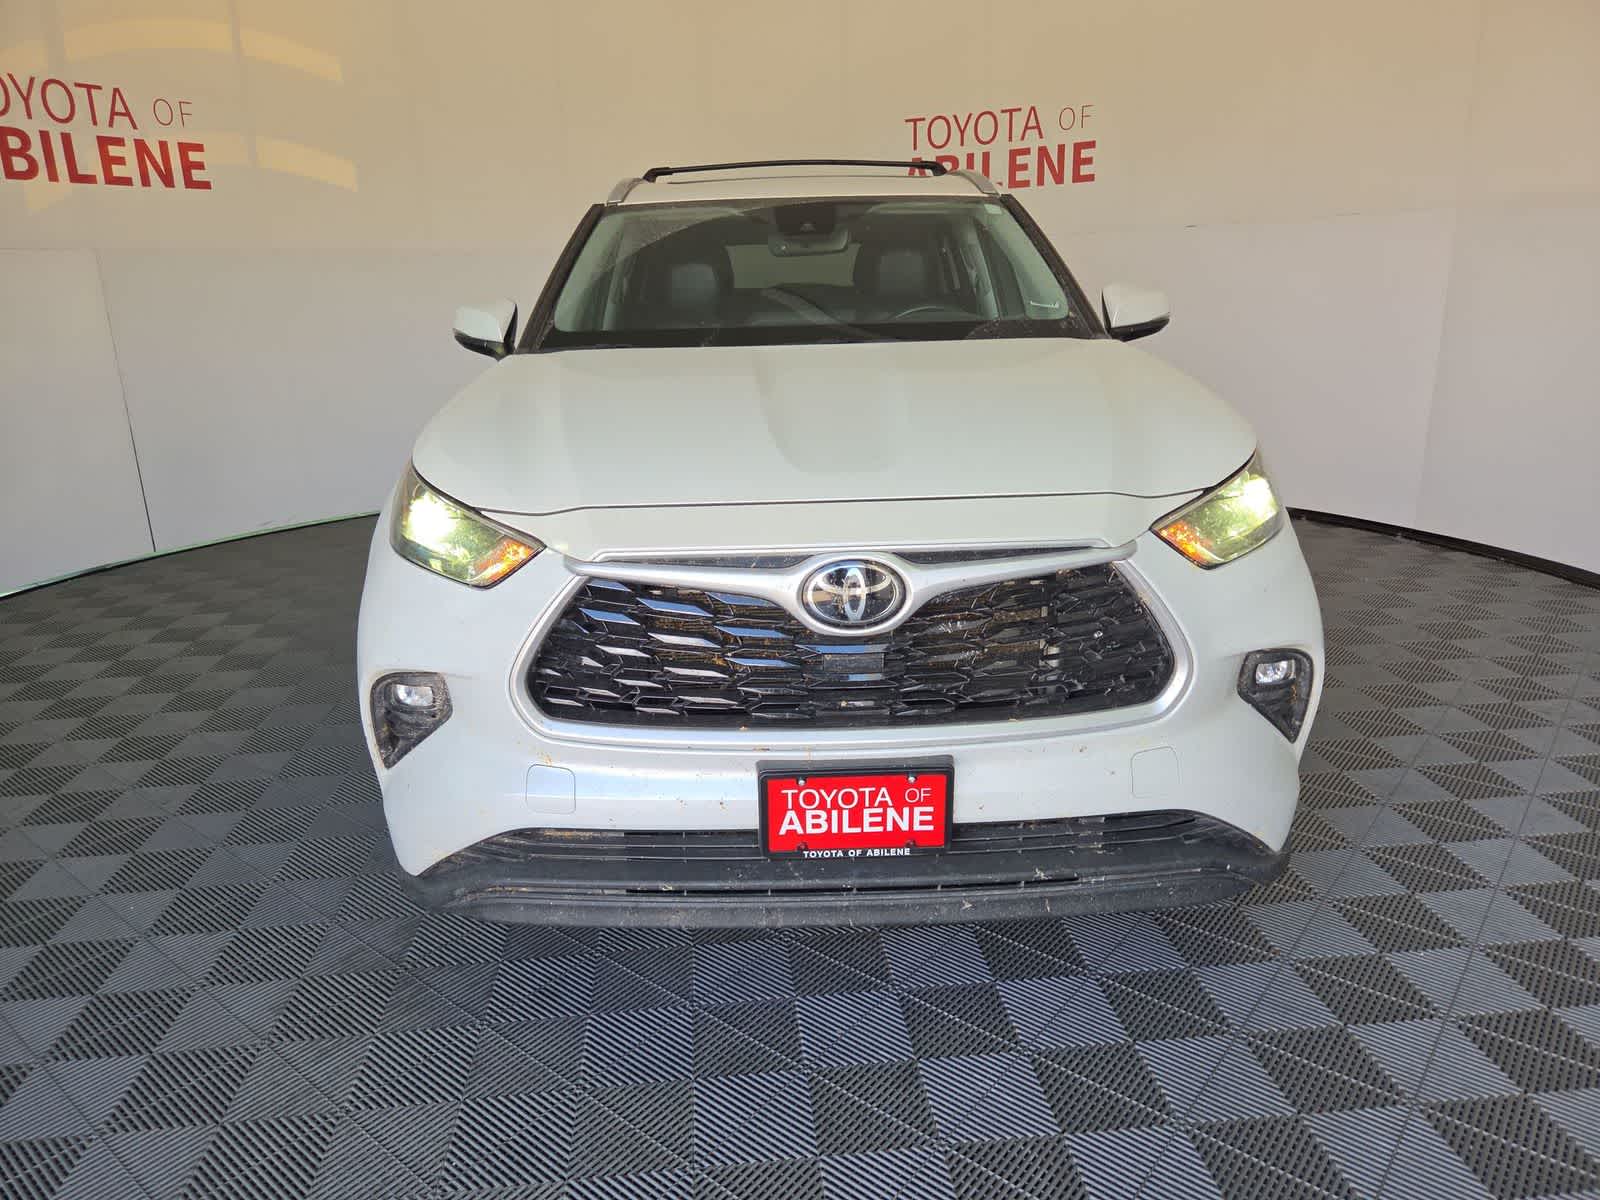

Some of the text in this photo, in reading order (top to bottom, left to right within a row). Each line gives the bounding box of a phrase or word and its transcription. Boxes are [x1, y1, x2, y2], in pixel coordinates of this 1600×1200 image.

[152, 98, 193, 127] OF
[904, 104, 1095, 151] TOYOTA OF
[906, 140, 1096, 189] LENE
[781, 787, 932, 810] TOYOTA OF
[778, 806, 934, 836] ABILENE
[803, 847, 911, 859] TOYOTA OF ABILENE
